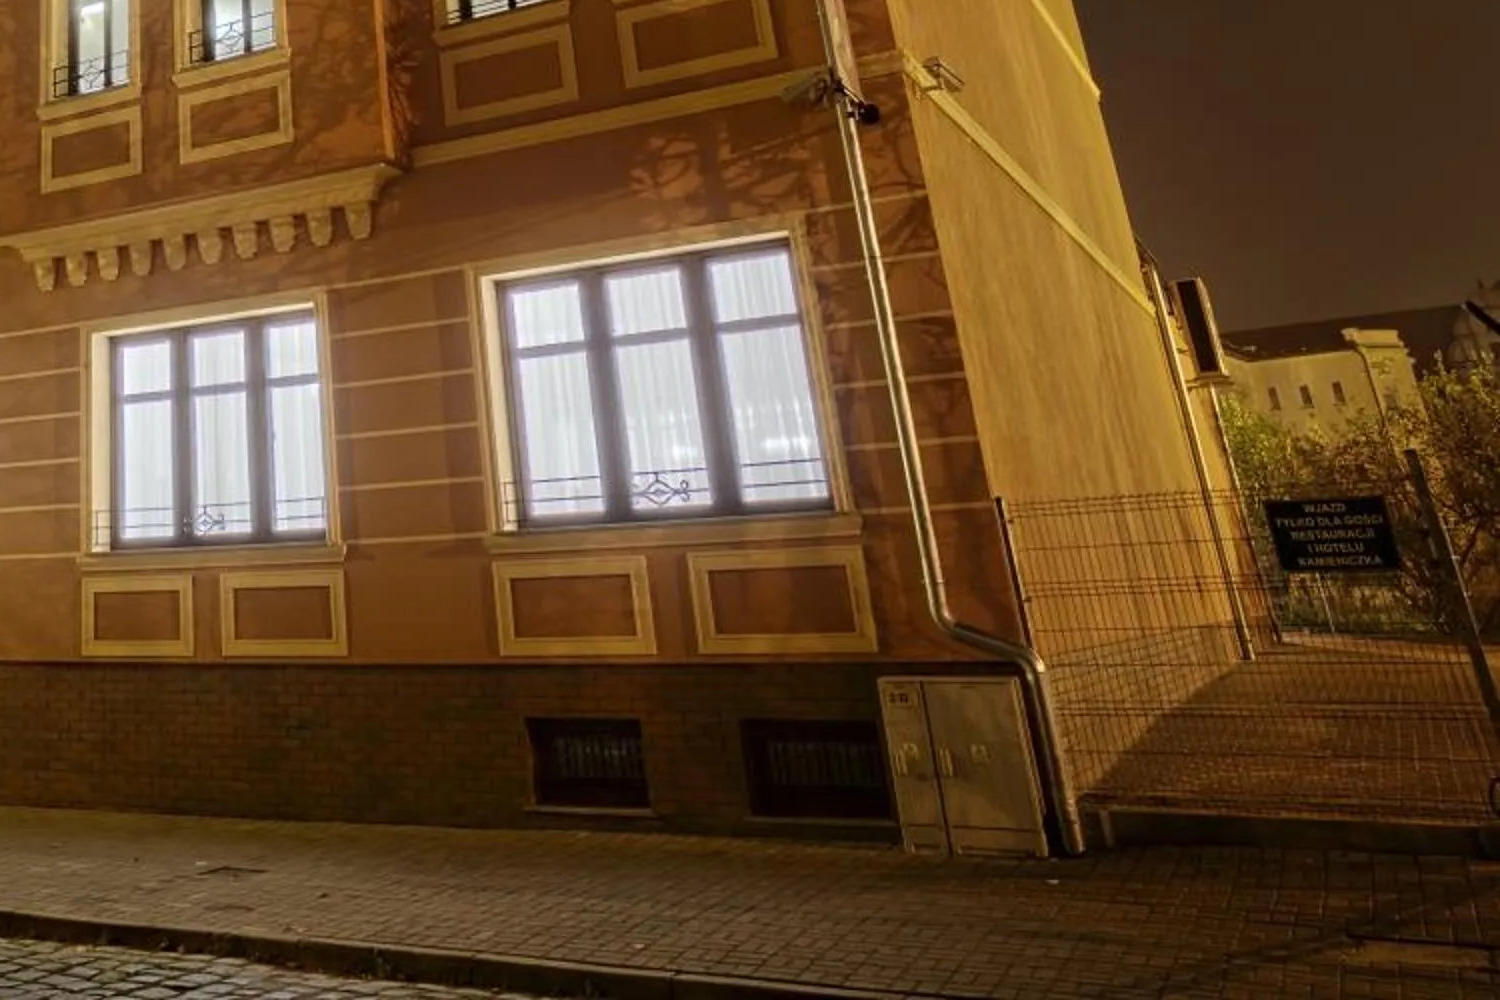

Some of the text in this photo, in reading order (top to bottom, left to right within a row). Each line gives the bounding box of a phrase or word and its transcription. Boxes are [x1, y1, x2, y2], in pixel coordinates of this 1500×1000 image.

[1302, 503, 1347, 513] WJAZD
[1276, 513, 1384, 528] TYLKO DLA GOŚCI
[1315, 542, 1364, 553] HOTELU
